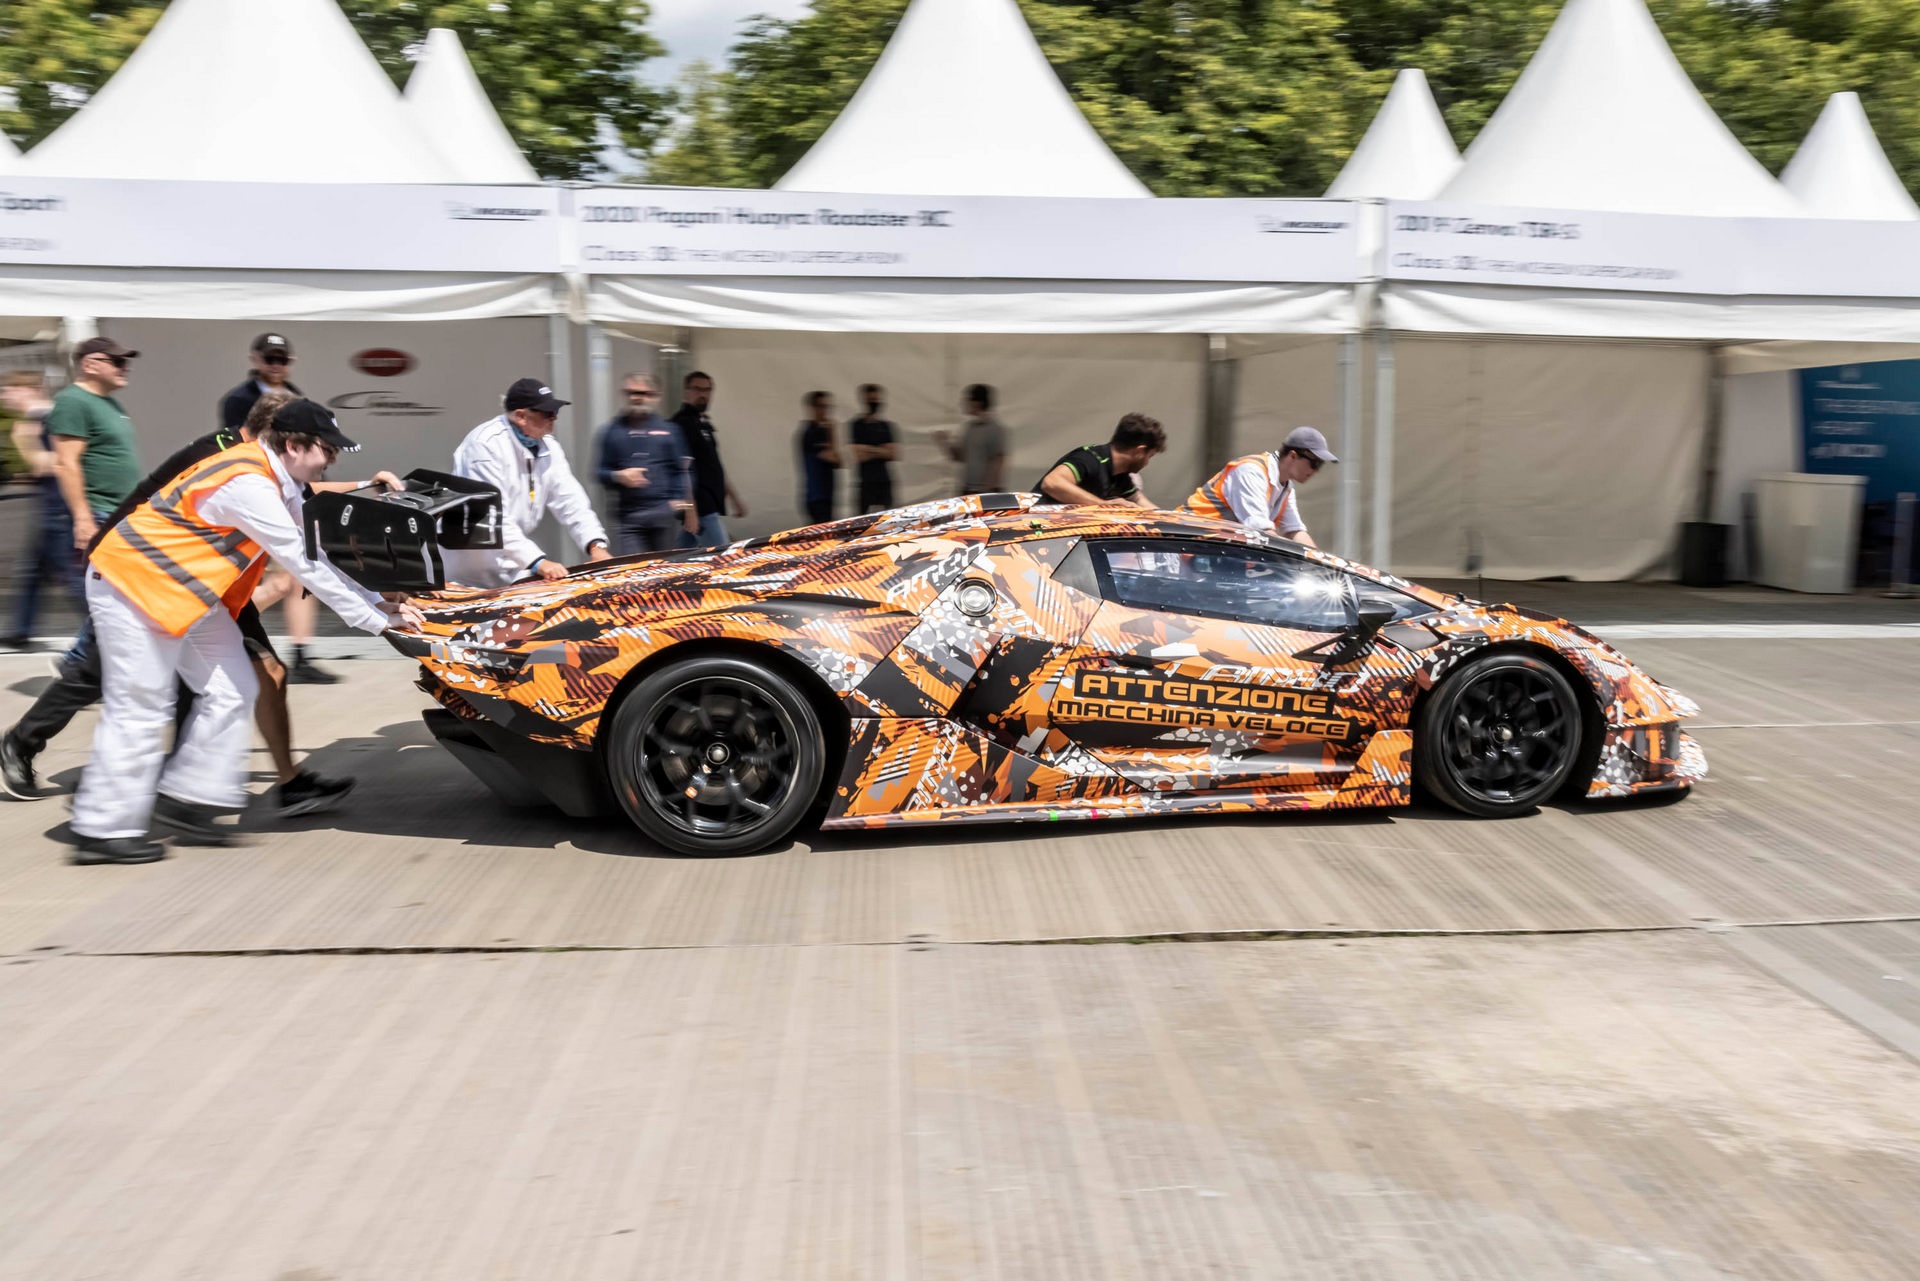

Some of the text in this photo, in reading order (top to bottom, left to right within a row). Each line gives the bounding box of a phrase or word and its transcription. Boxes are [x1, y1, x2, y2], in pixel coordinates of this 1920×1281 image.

[1081, 673, 1329, 713] ATTENZIONE
[1057, 700, 1348, 738] MACCHINA VELOCE
